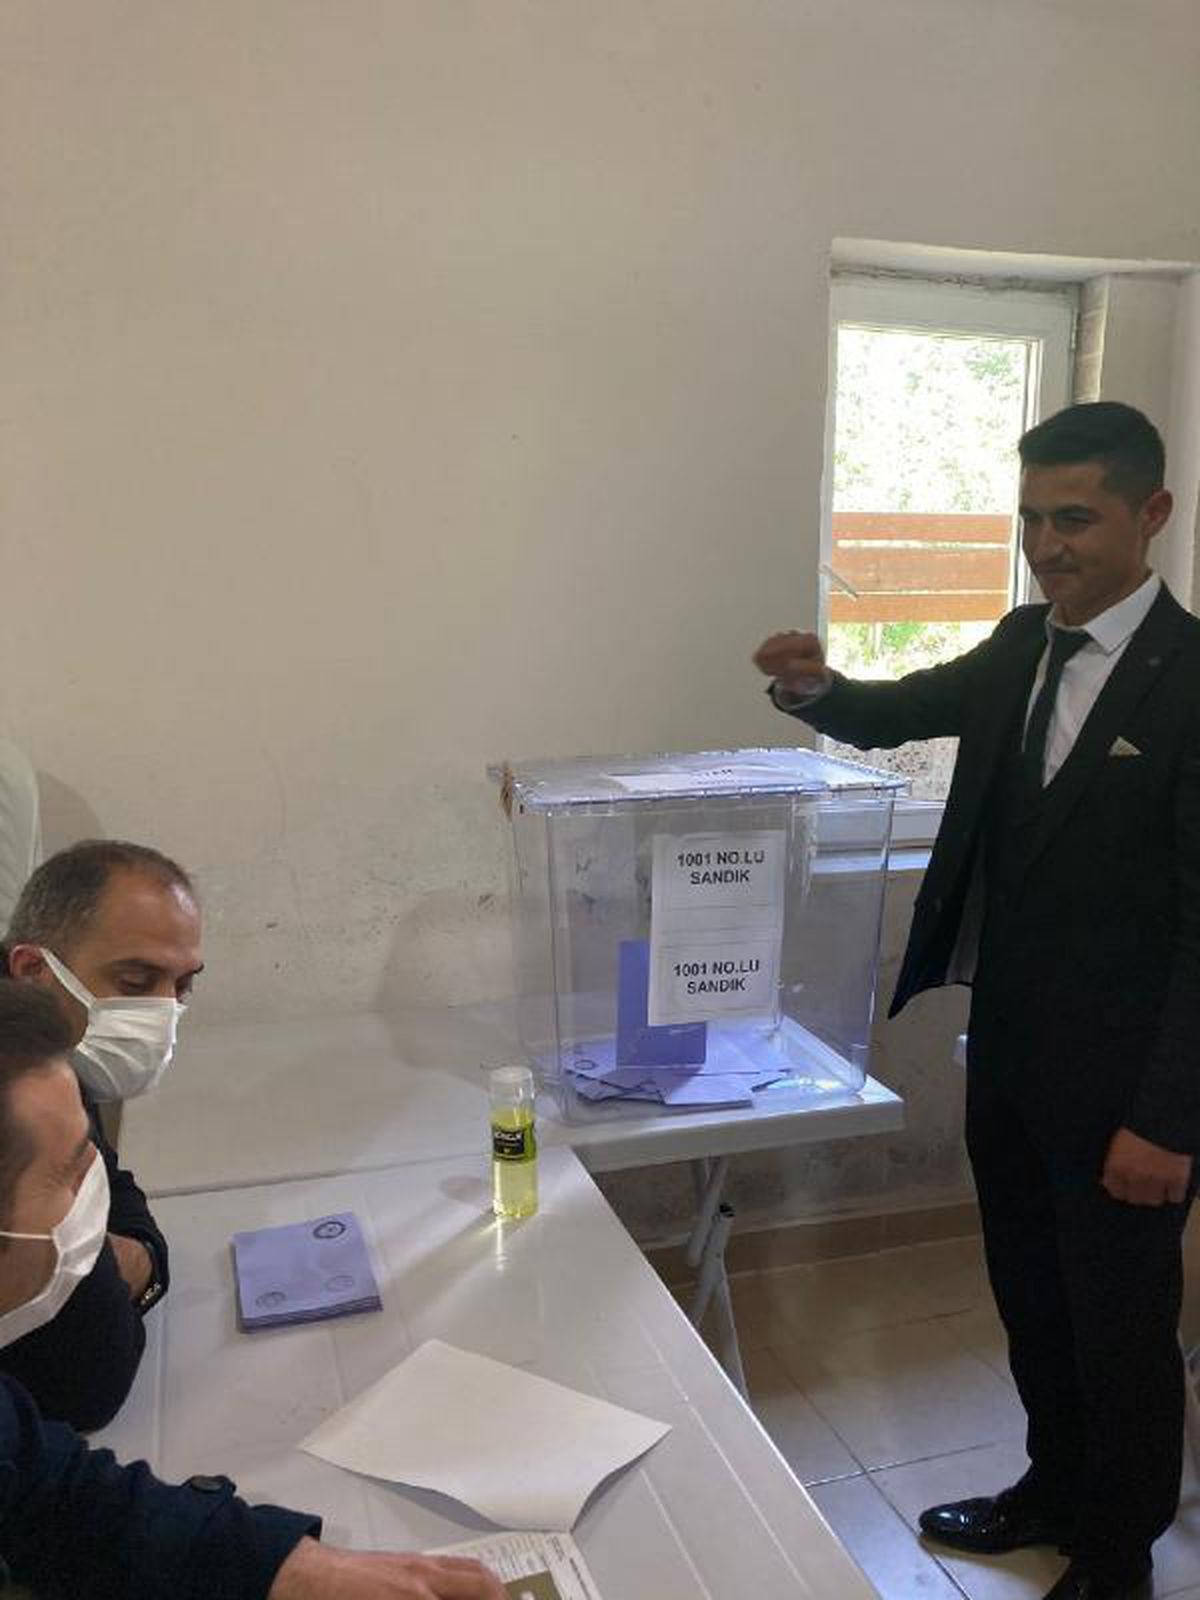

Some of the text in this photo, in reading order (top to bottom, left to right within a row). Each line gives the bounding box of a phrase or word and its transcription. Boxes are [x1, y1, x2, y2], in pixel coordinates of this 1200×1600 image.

[677, 851, 765, 867] 1001 NO.LU
[690, 869, 750, 885] SANDIK
[673, 960, 760, 977] 1001 NO.LU
[687, 978, 746, 994] SANDIK
